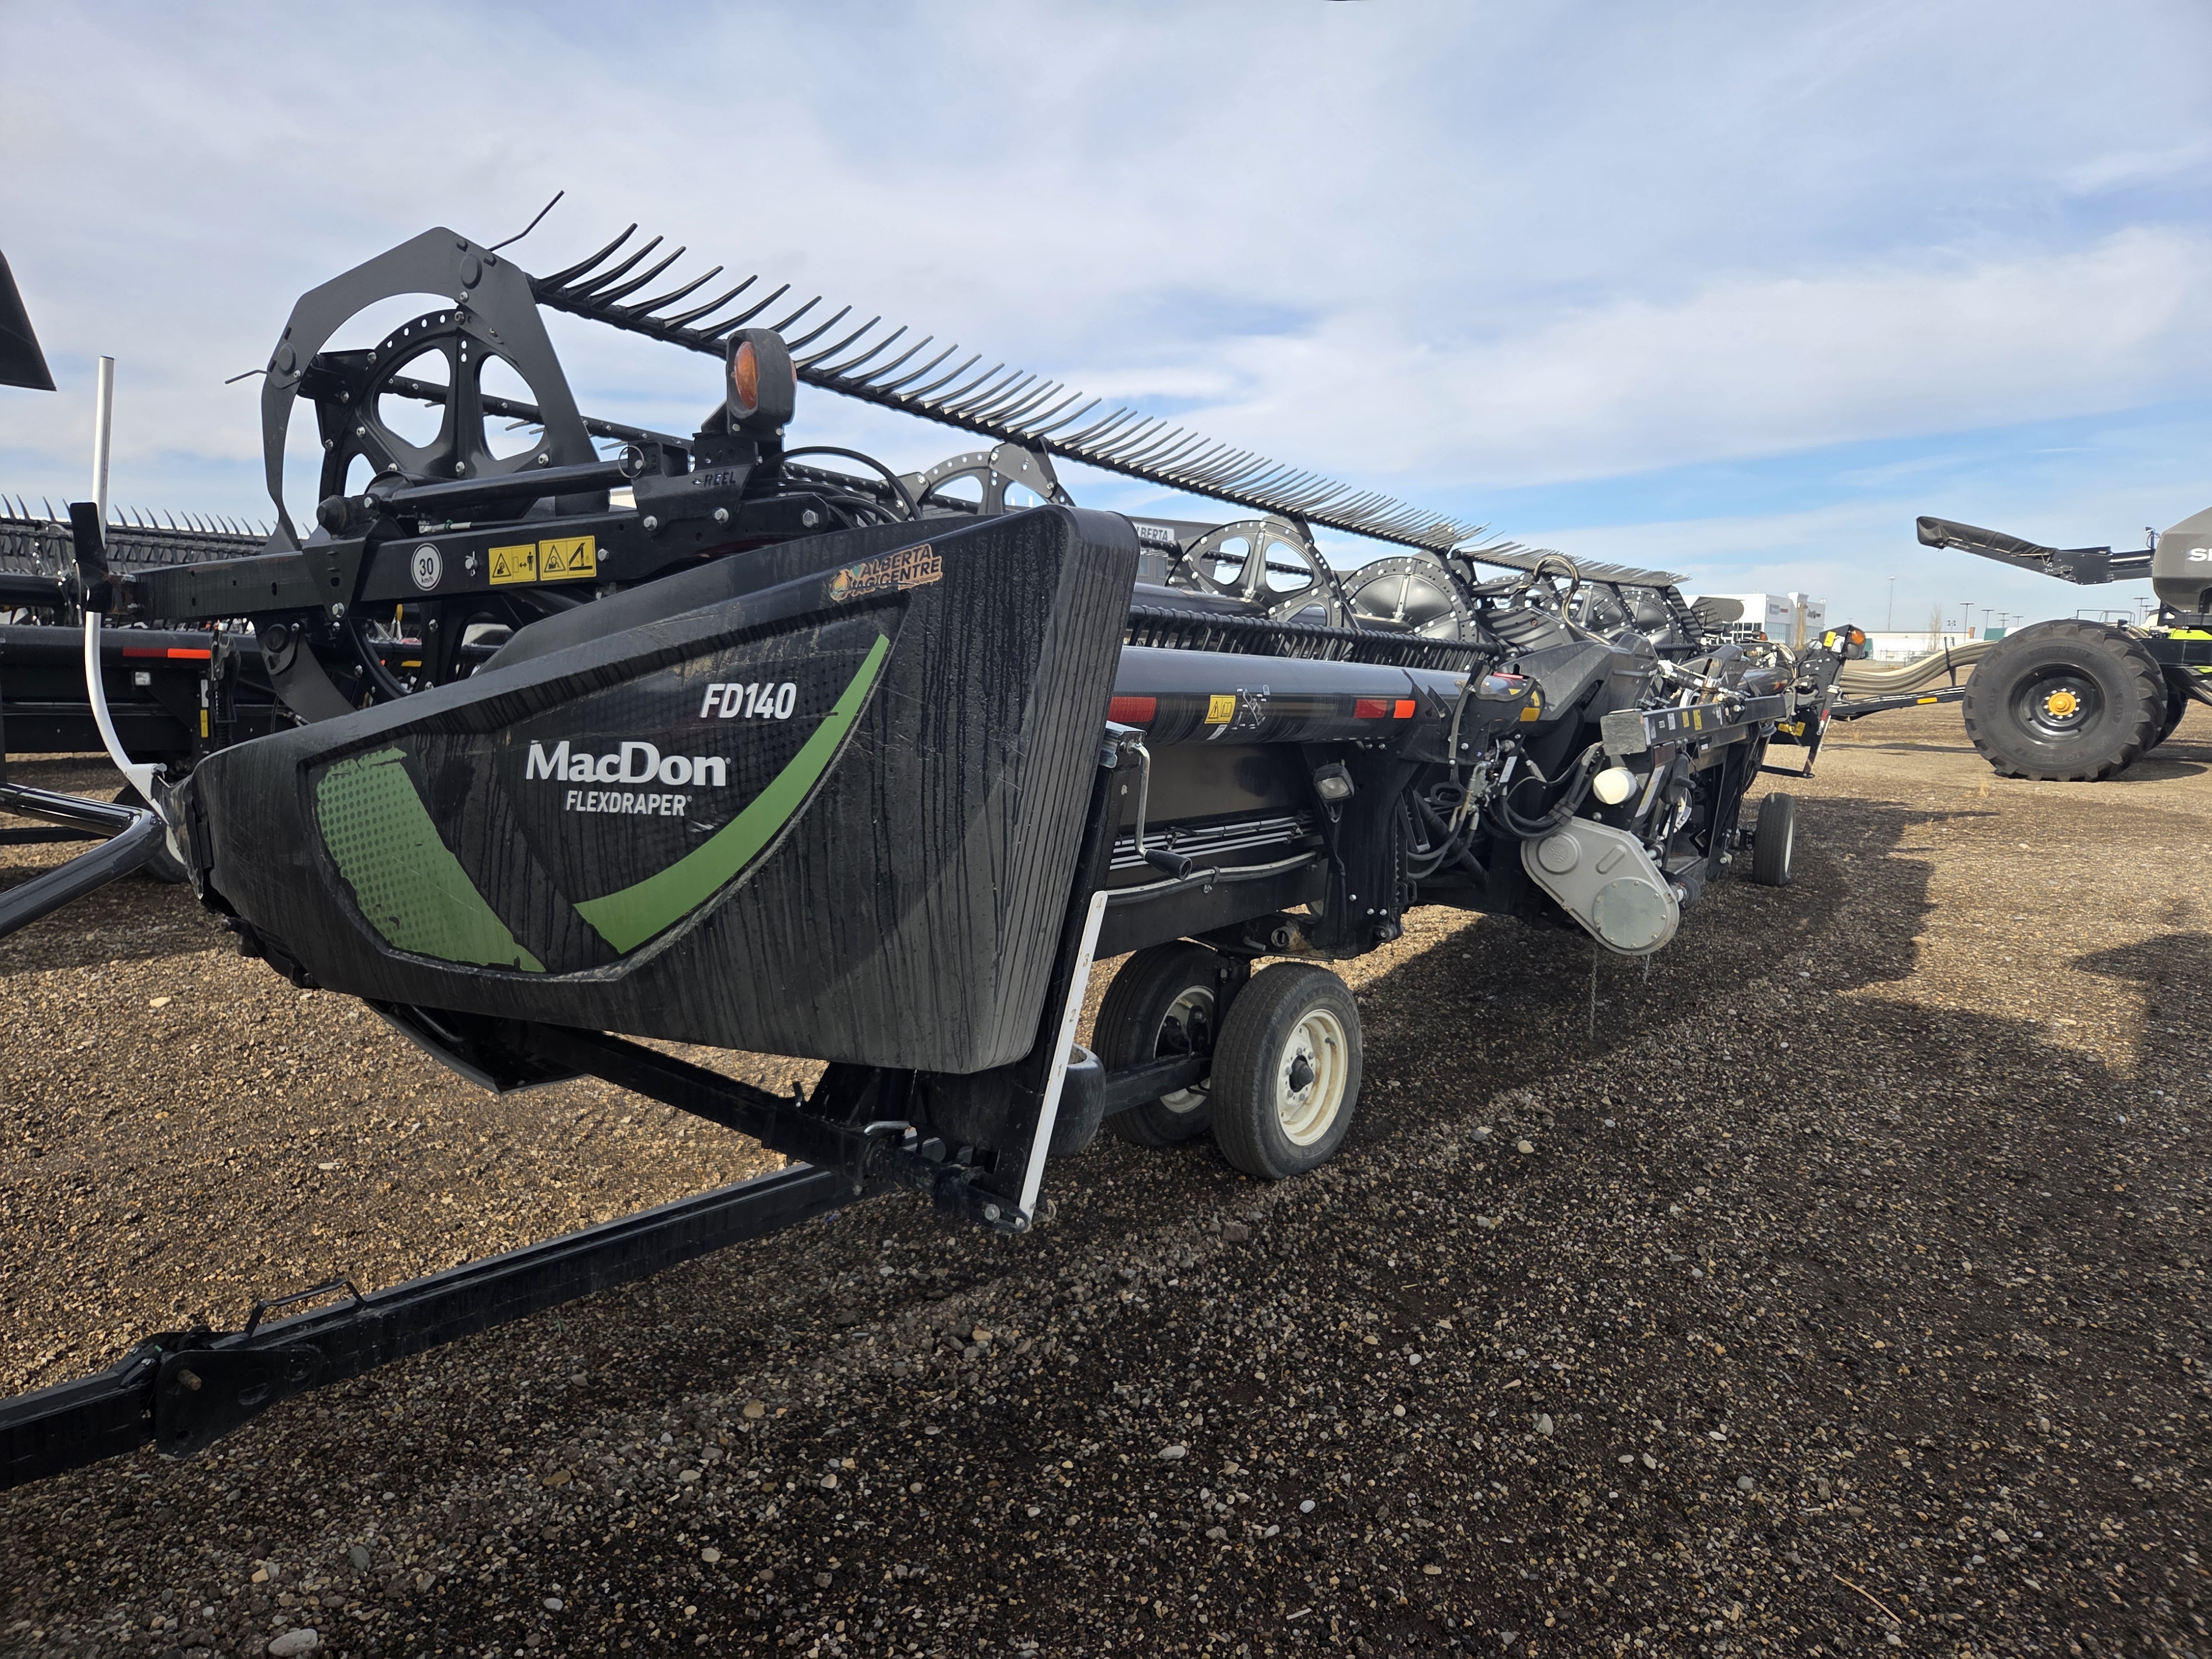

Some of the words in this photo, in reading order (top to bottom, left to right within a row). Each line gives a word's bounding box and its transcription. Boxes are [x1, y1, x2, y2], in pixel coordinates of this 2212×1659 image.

[1137, 526, 1168, 542] BERTA
[860, 545, 931, 578] ALBERTA
[2189, 547, 2212, 562] S
[419, 557, 434, 576] 30
[880, 558, 941, 585] CENTRE
[700, 682, 797, 719] FD140
[1095, 897, 1103, 911] 4
[1082, 953, 1090, 968] 3
[1068, 1008, 1077, 1023] 2
[1057, 1063, 1063, 1078] 1
